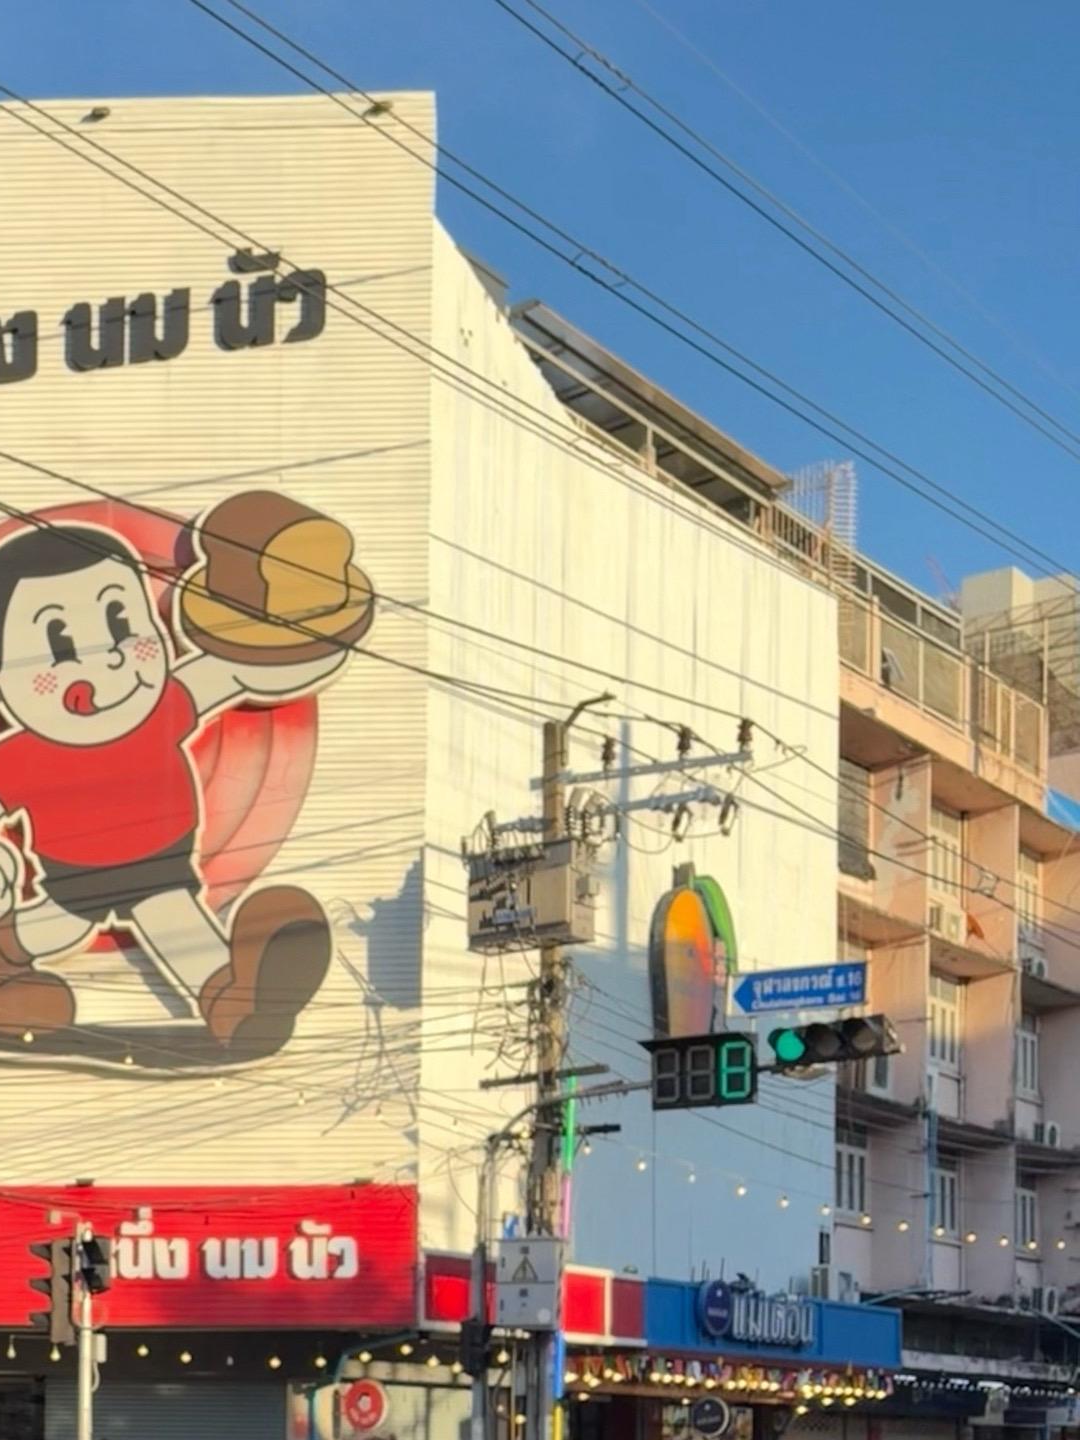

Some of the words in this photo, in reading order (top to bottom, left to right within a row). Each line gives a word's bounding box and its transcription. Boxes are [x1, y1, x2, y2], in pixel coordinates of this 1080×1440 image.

[60, 287, 191, 373] นม
[209, 247, 328, 352] นัว
[109, 1206, 189, 1279] นึ่ง
[202, 1236, 278, 1279] นม
[292, 1219, 358, 1279] นัว
